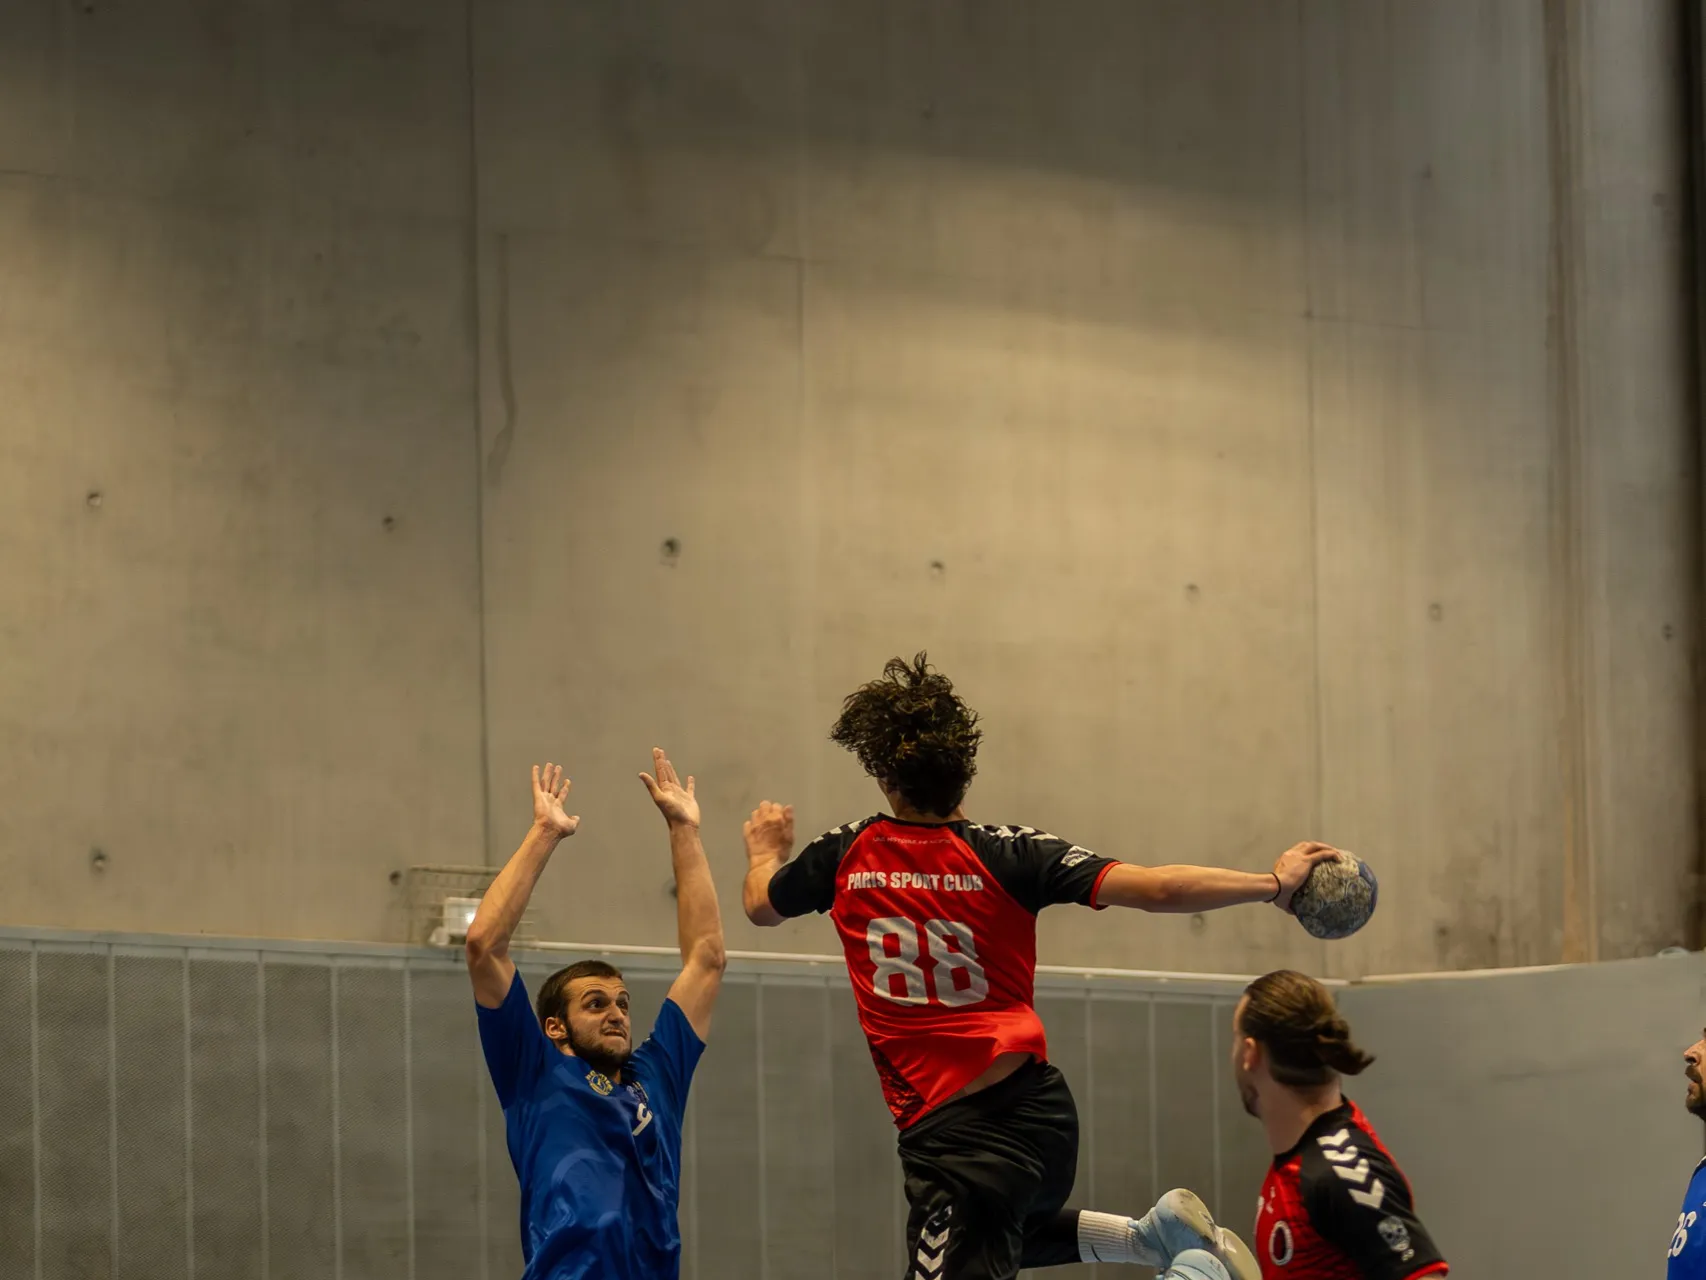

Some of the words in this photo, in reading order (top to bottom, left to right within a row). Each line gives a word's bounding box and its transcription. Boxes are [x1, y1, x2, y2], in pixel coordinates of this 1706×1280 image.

[847, 871, 887, 890] PARIS
[890, 872, 940, 891] SPORT
[943, 873, 984, 891] CLUB
[866, 916, 989, 1008] 88
[632, 1103, 653, 1136] 9
